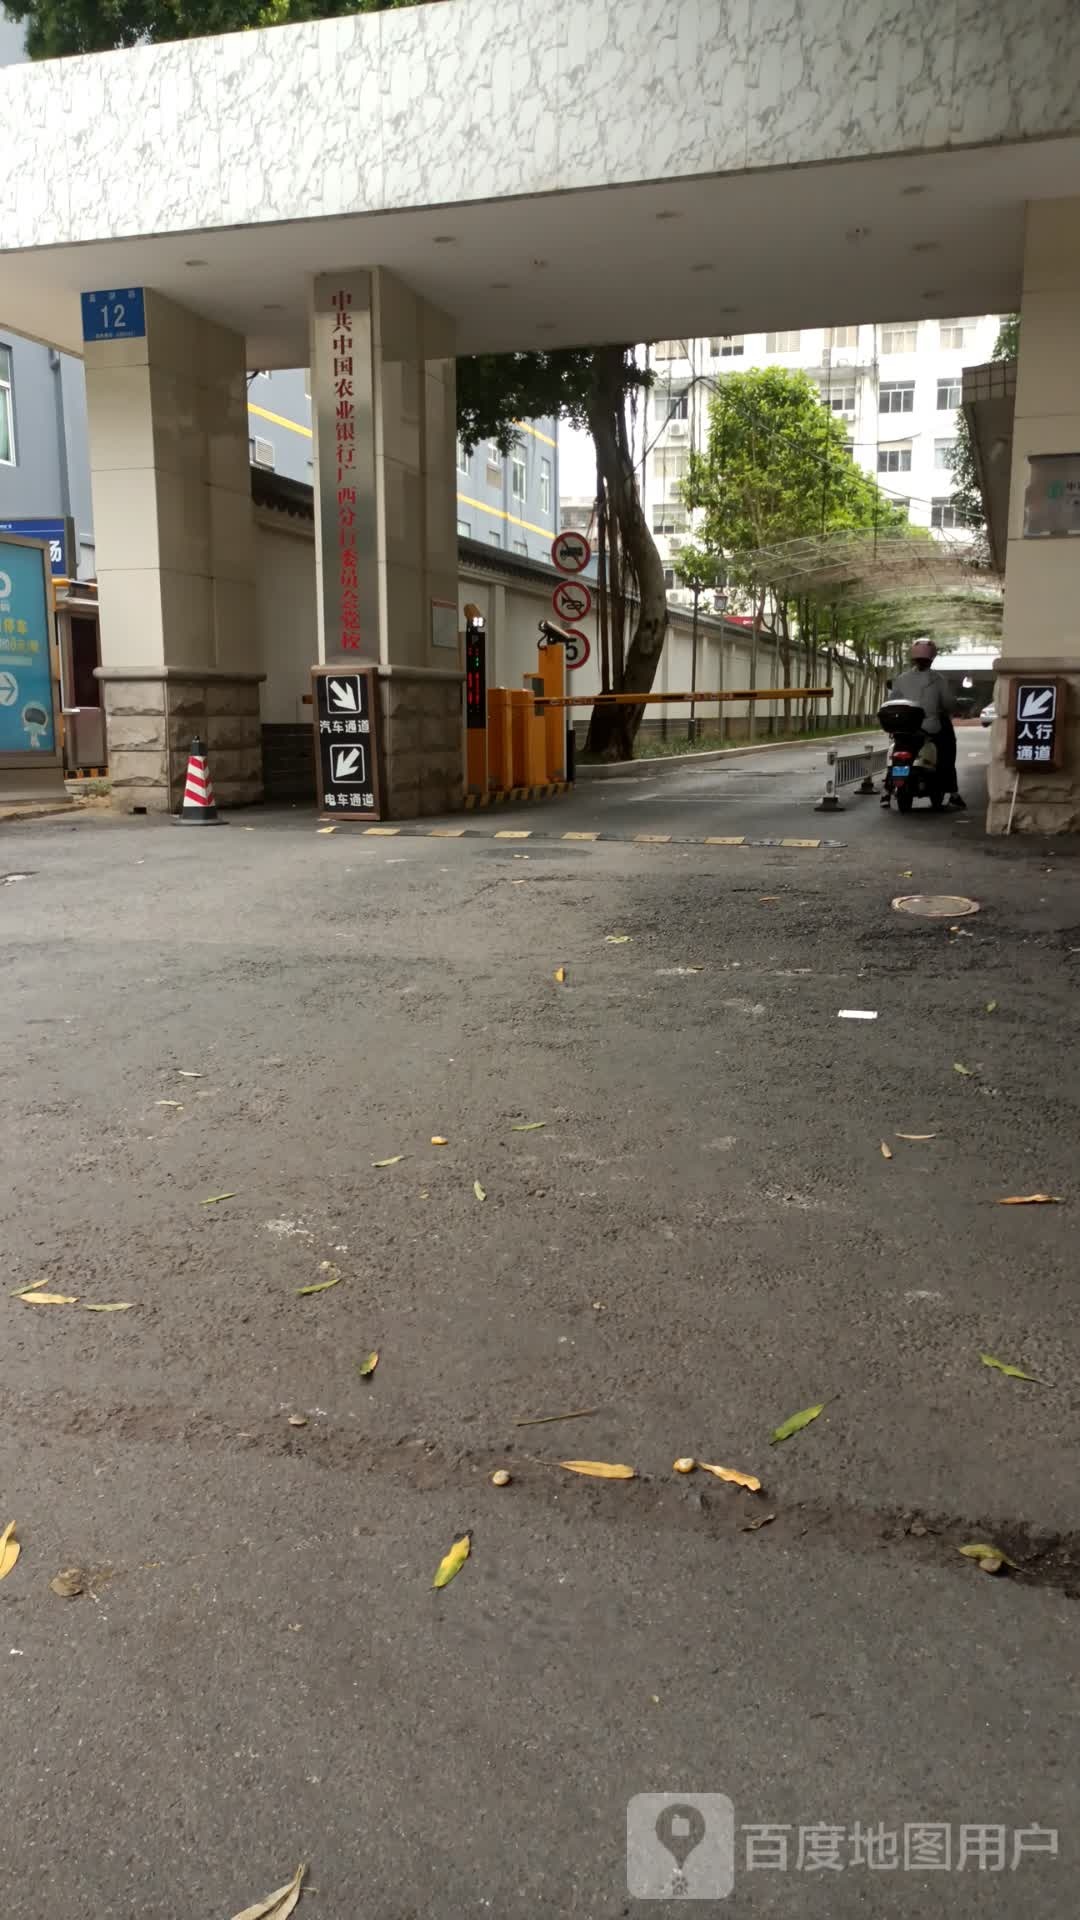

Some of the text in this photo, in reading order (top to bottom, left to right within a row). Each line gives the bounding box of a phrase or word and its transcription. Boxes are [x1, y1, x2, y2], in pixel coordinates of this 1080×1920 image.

[100, 304, 127, 328] 12
[332, 290, 361, 649] 中共中国农业银行广西分行委员会党校
[320, 719, 370, 734] 汽车通道
[1017, 722, 1053, 740] 人行
[1016, 745, 1051, 761] 通道
[324, 793, 374, 807] 电车通道
